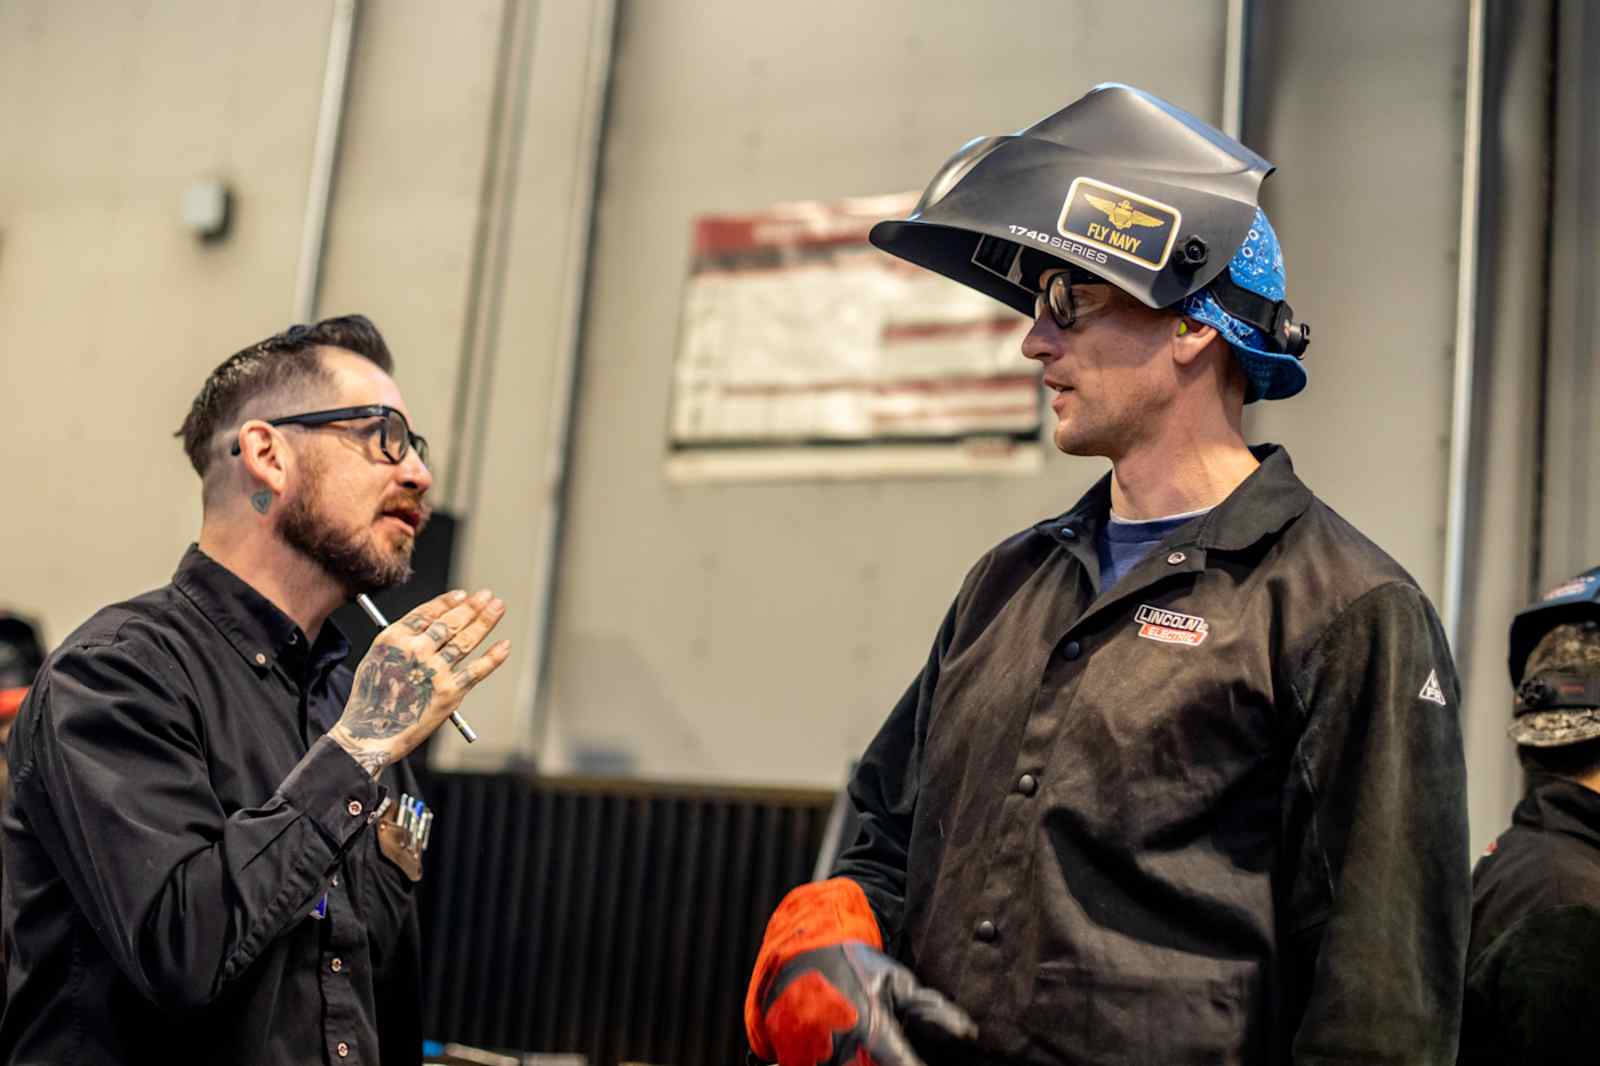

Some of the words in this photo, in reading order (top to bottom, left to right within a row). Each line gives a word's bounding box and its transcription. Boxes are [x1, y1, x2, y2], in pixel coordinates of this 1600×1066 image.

[1008, 224, 1049, 243] 1740
[1050, 236, 1108, 264] SERIES
[1087, 222, 1110, 241] FLY
[1109, 229, 1142, 253] NAVY
[1139, 607, 1199, 632] LINCOLN
